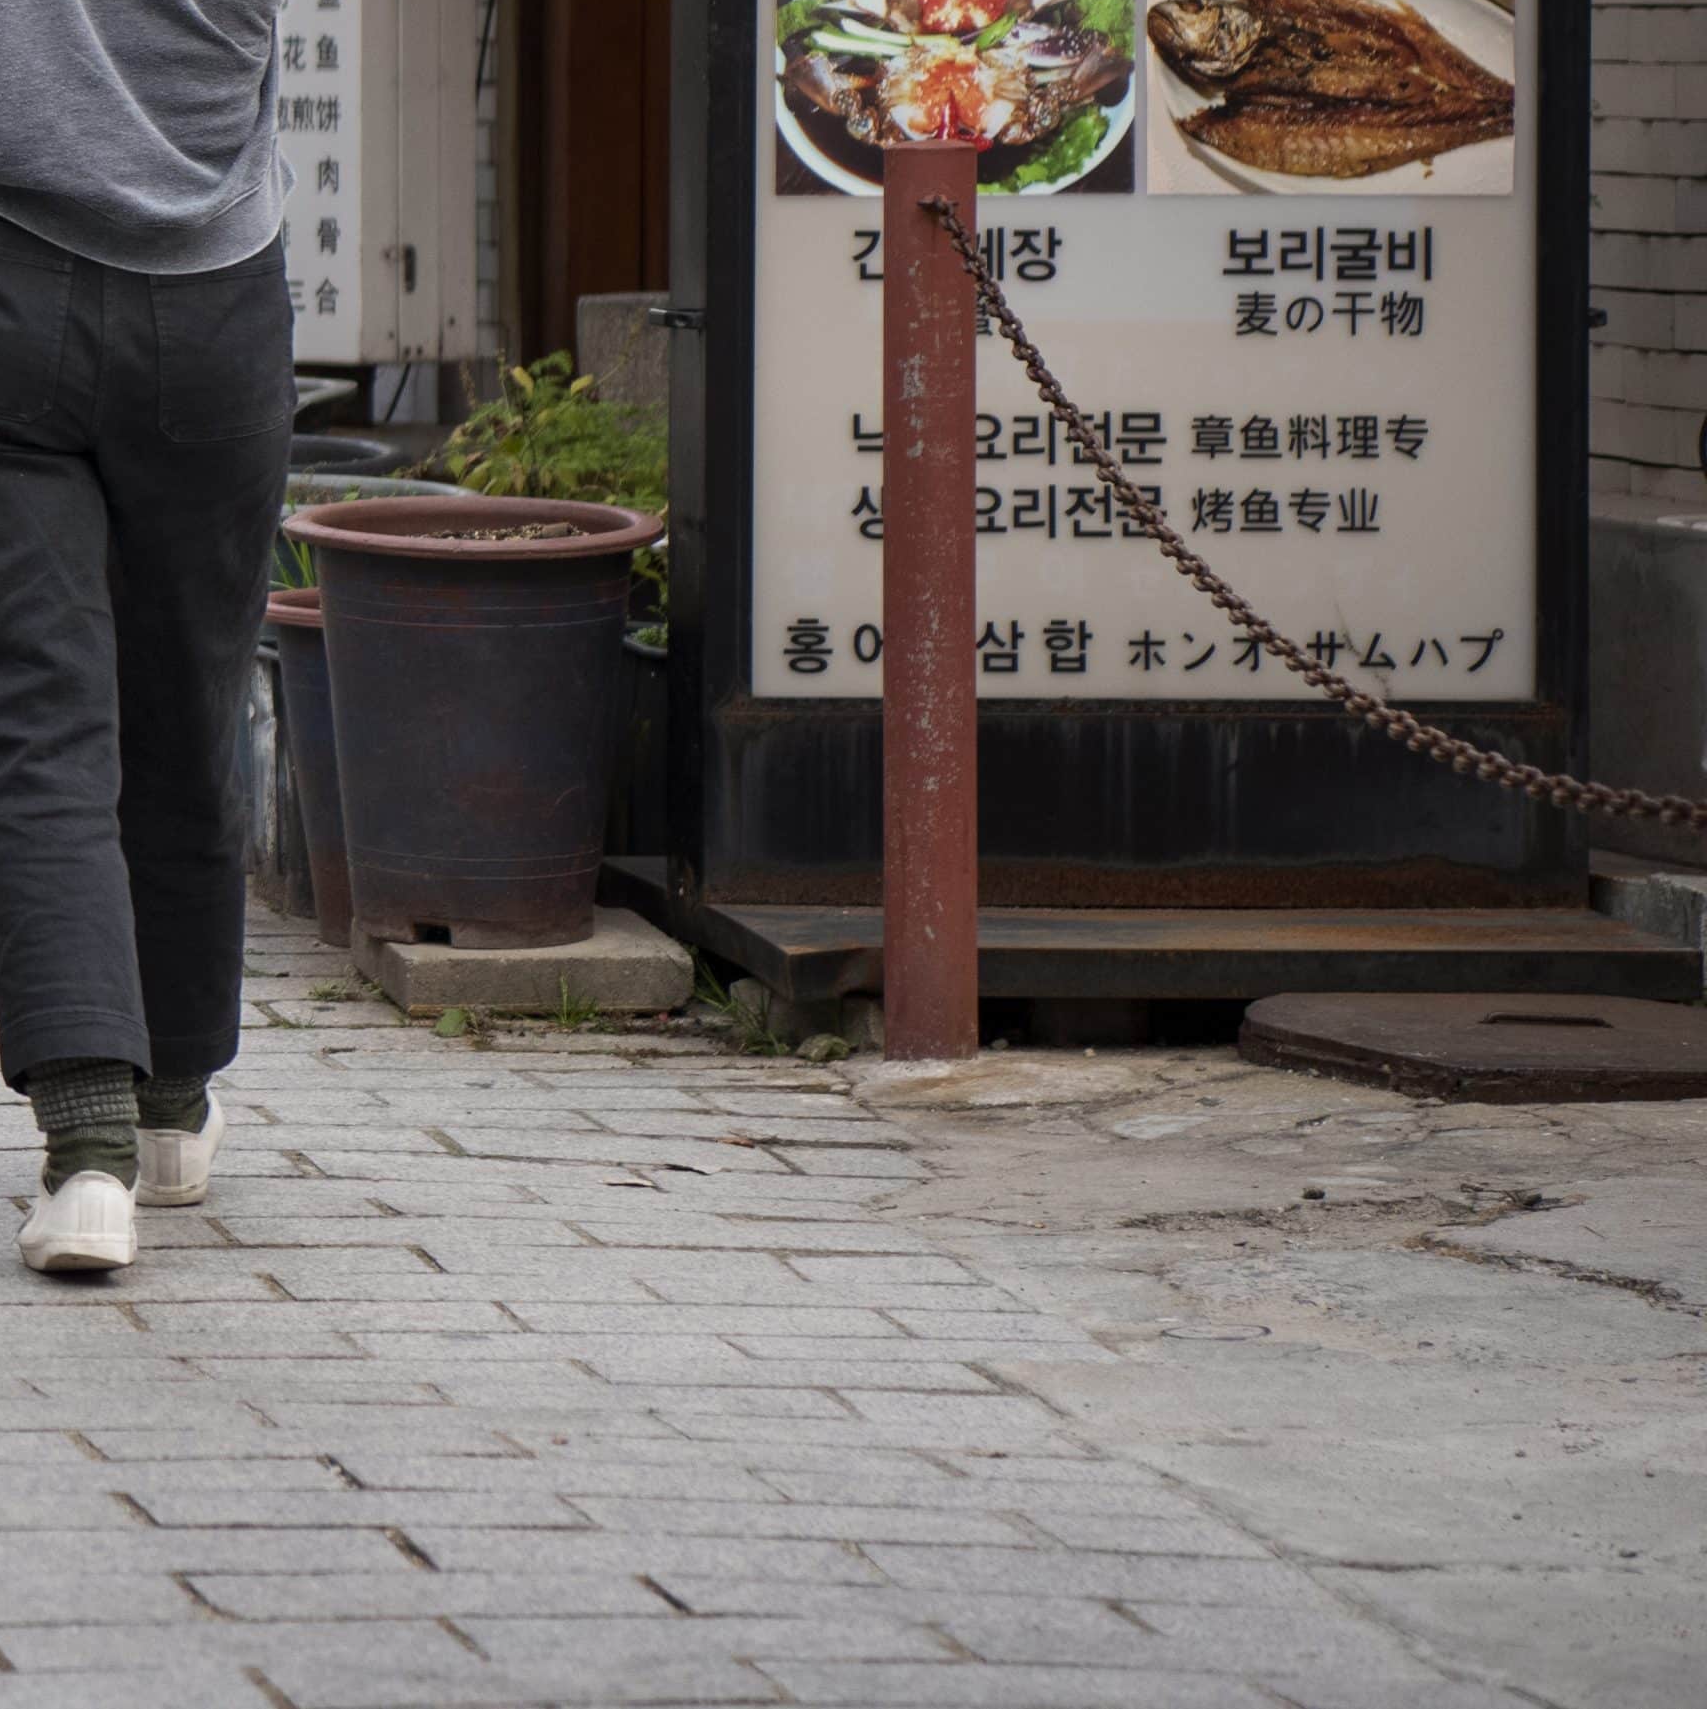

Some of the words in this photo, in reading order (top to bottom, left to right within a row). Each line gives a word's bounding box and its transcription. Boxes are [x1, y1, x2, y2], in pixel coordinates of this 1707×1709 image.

[1222, 226, 1433, 281] 보리굴비
[1235, 291, 1425, 337] 麦の干物
[1191, 414, 1429, 460] 章鱼料理专
[1191, 487, 1381, 533] 烤鱼专业
